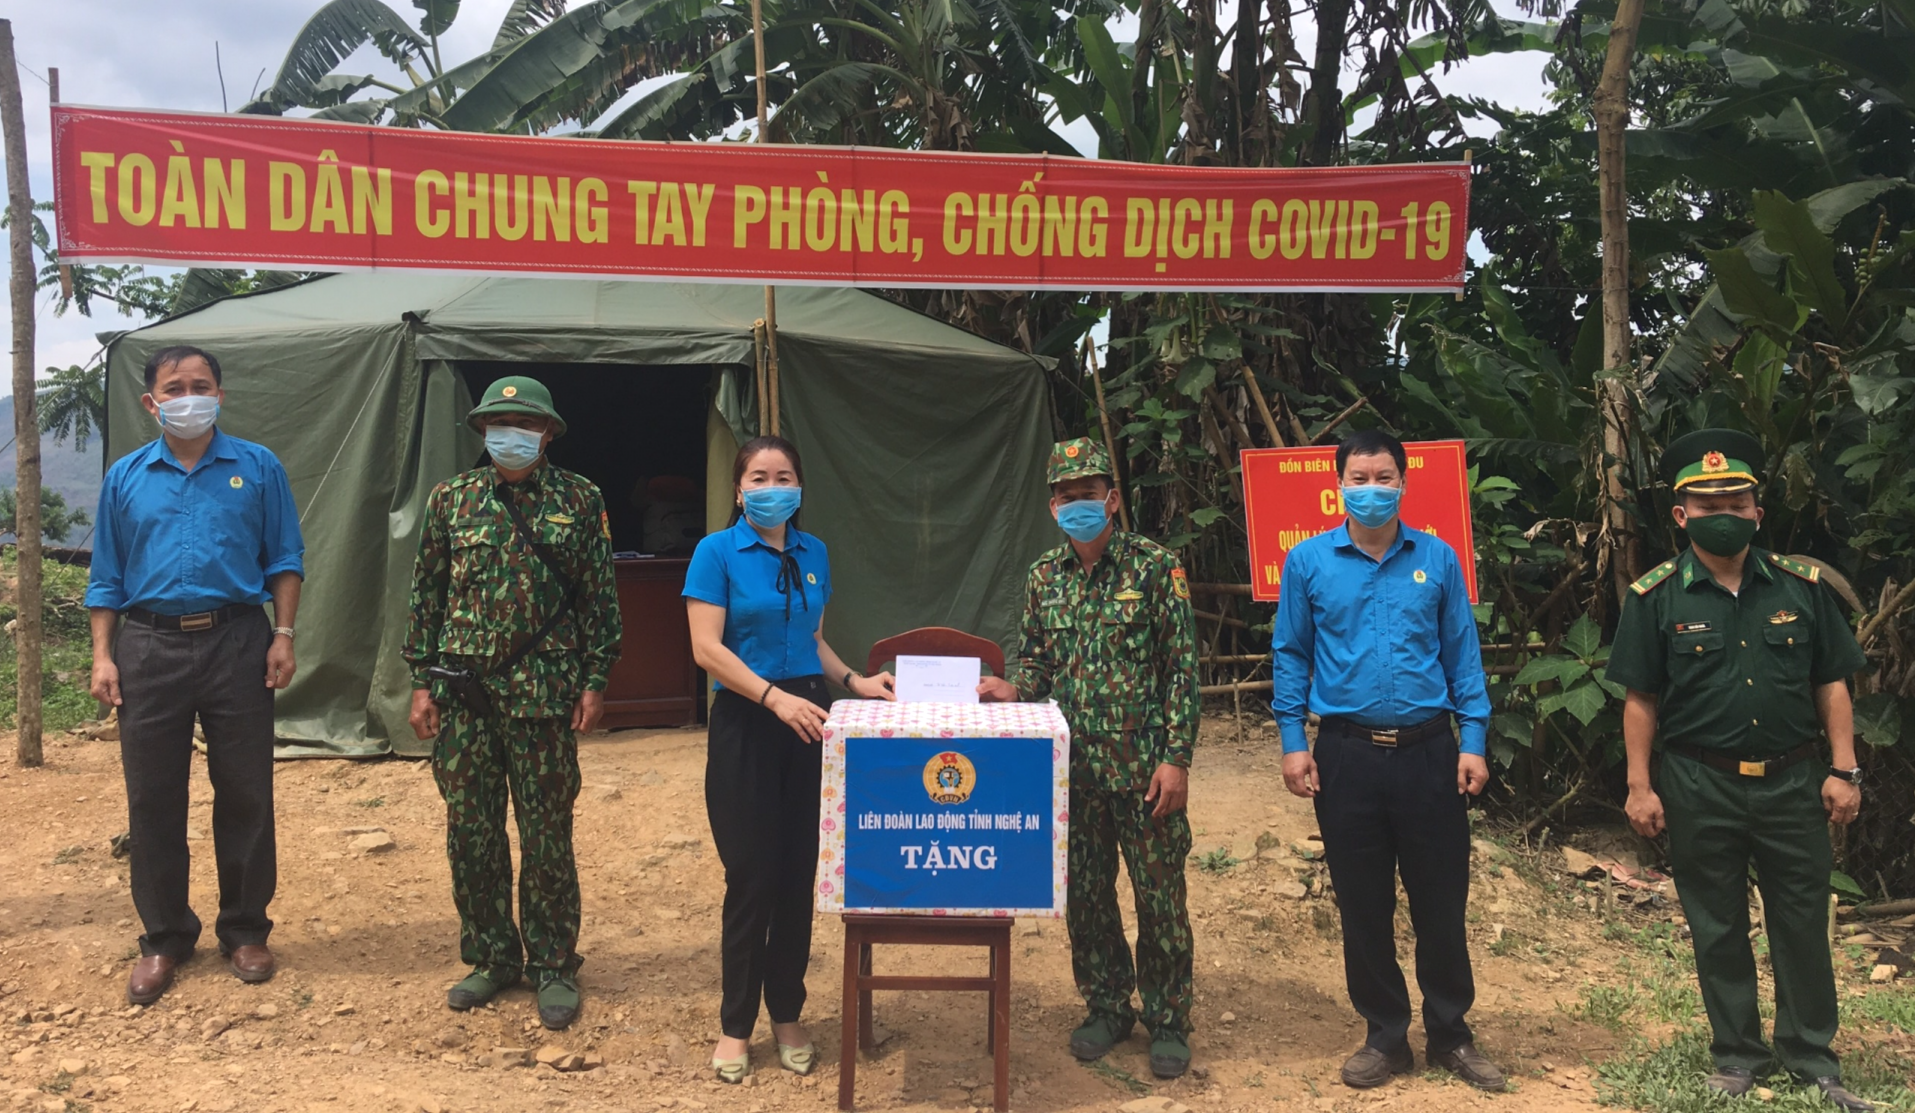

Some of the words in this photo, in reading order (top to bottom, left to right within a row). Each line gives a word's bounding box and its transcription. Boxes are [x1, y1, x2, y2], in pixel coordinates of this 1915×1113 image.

[80, 140, 247, 230] TOÀN
[269, 149, 393, 236] DÂN
[414, 169, 609, 244] CHUNG
[627, 180, 716, 247] TAY
[733, 171, 924, 262] PHÒNG,
[942, 172, 1109, 258] CHỐNG
[1124, 197, 1234, 273] DỊCH
[1248, 199, 1451, 261] COVID-19
[1305, 458, 1330, 472] BIÊN
[1265, 561, 1281, 585] VÀ
[858, 810, 882, 829] LIÊN
[884, 810, 913, 829] ĐOÀN
[915, 813, 935, 829] LAO
[937, 810, 966, 833] ĐỘNG
[968, 809, 992, 829] TỈNH
[995, 811, 1022, 833] NGHỆ
[1024, 814, 1040, 830] AN
[900, 839, 998, 876] TẶNG
